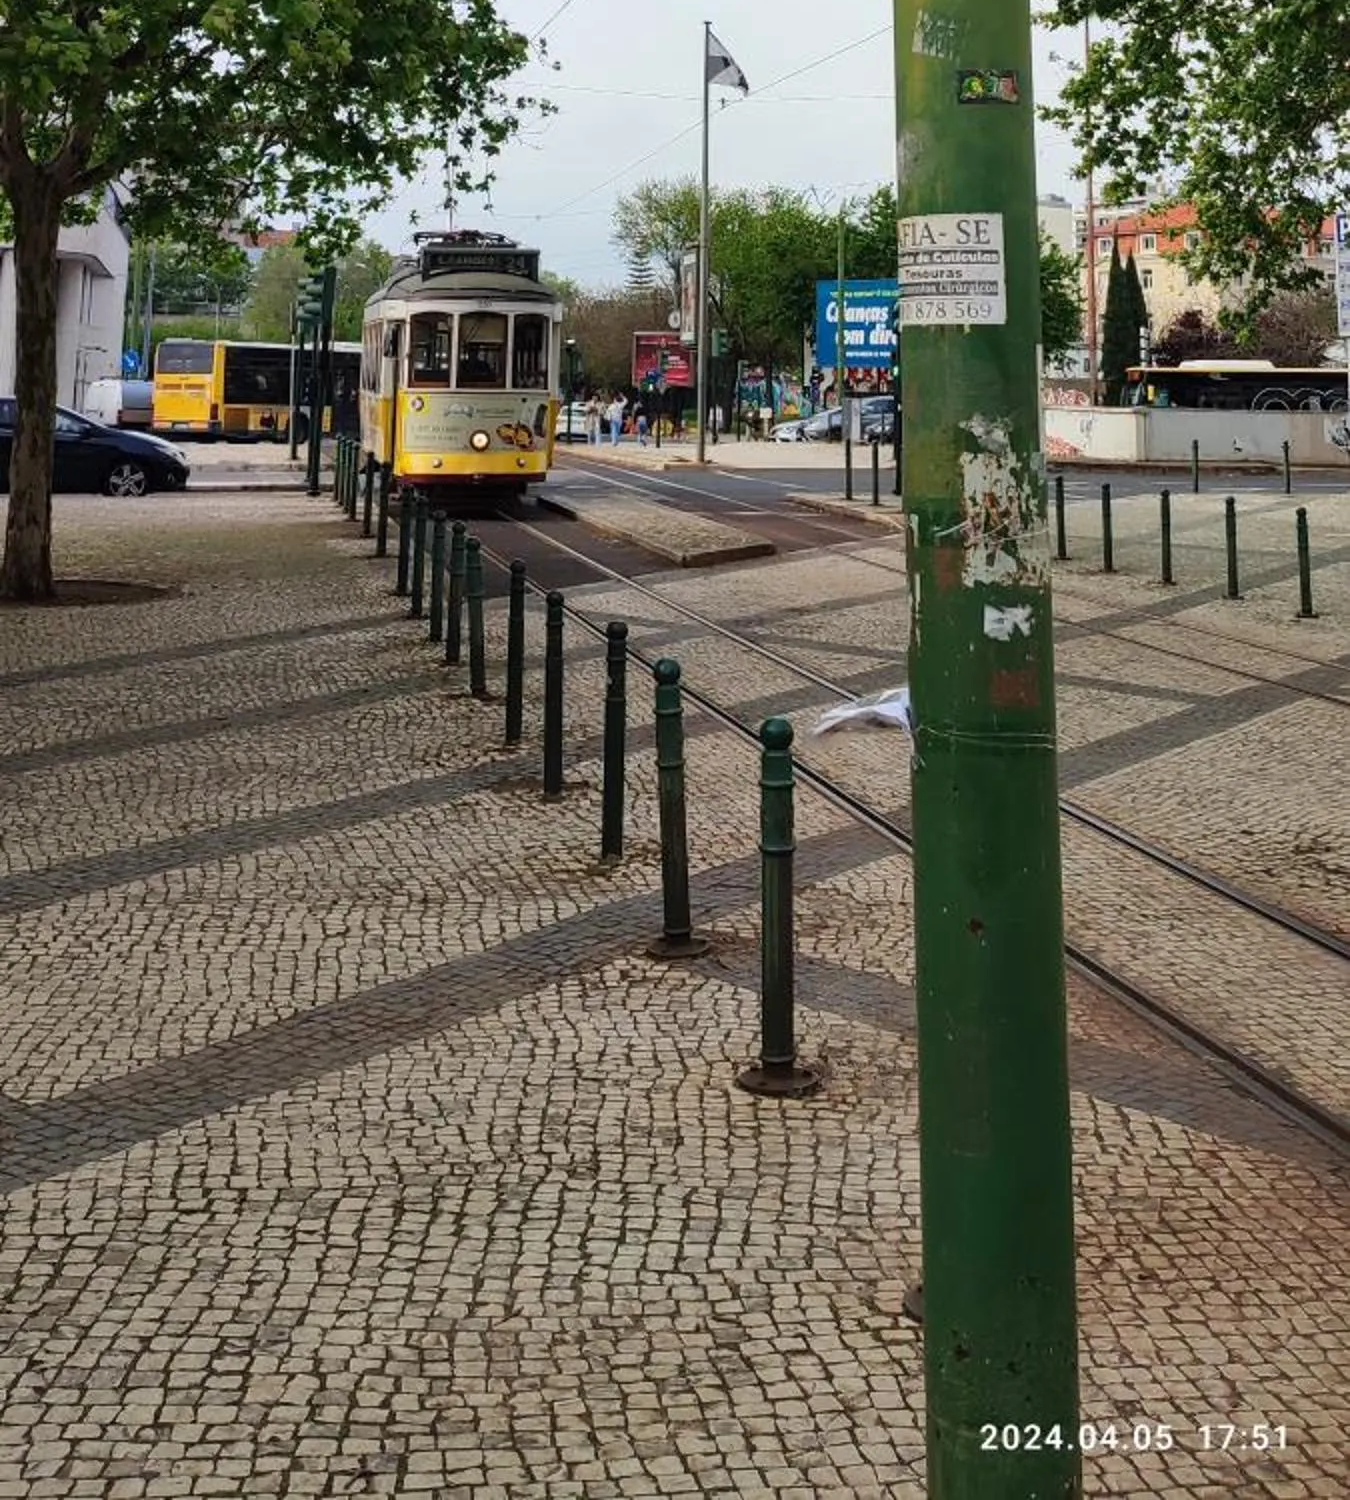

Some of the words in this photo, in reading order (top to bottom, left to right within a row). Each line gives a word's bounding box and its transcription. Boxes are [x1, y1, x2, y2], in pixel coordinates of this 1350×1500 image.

[900, 222, 946, 248] FIA-
[956, 219, 991, 245] SE
[915, 302, 947, 320] 878
[954, 302, 993, 320] 569
